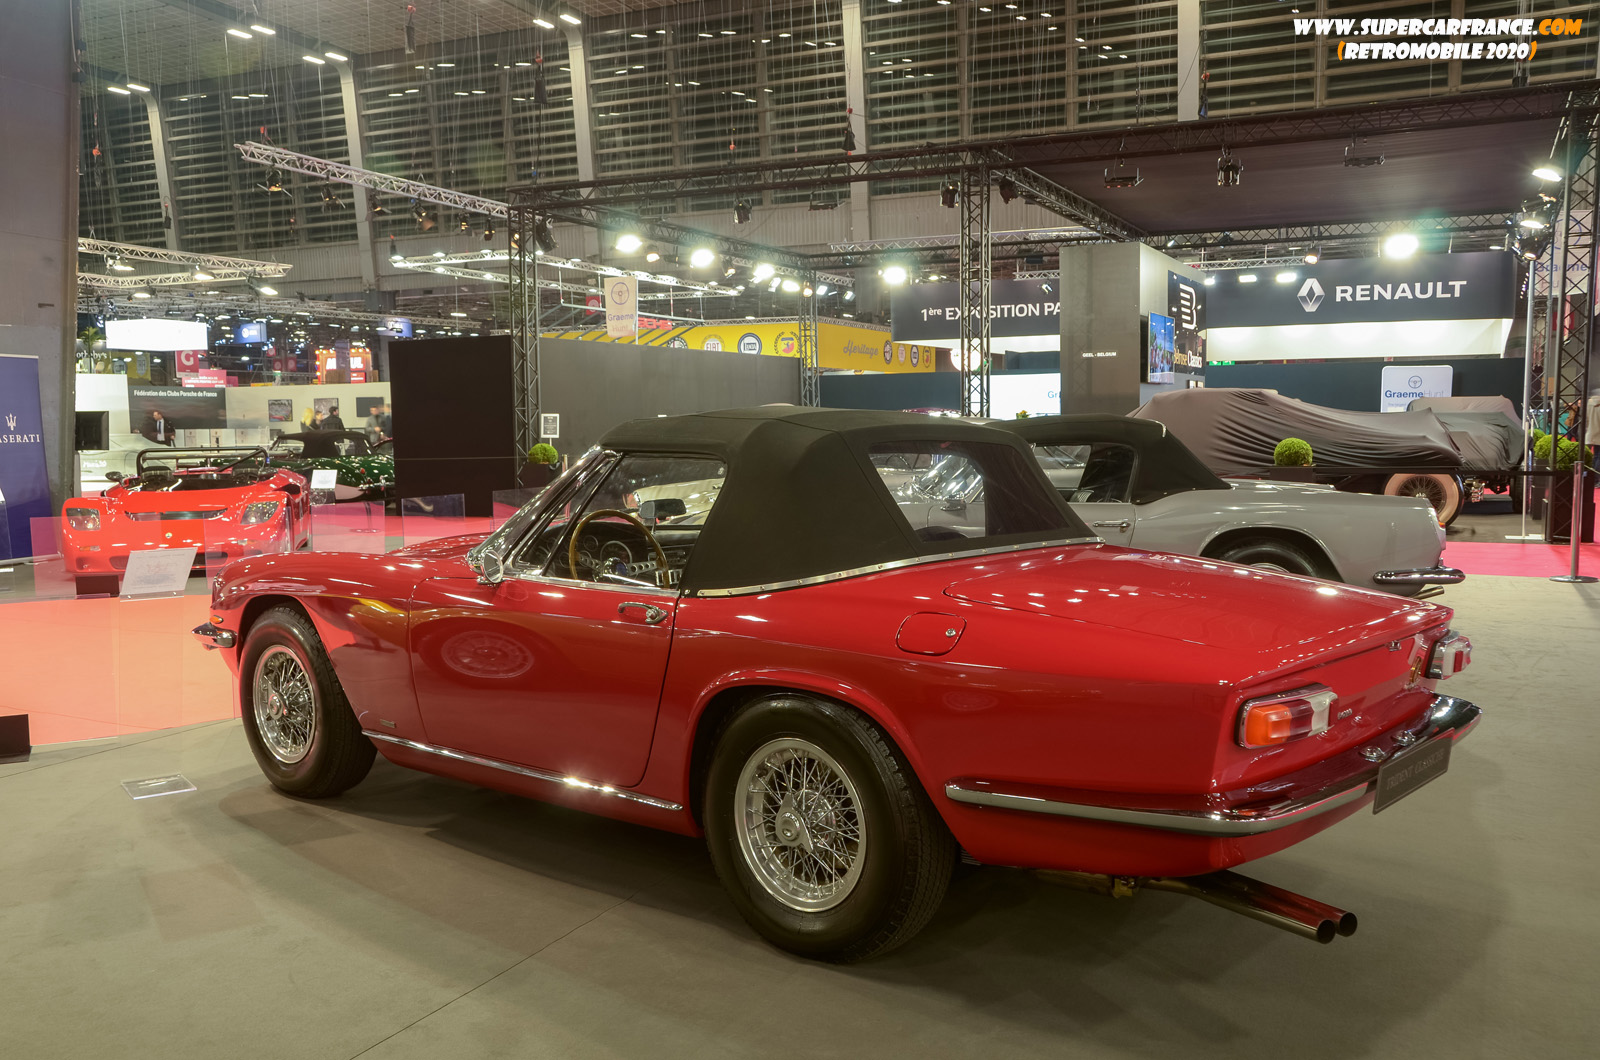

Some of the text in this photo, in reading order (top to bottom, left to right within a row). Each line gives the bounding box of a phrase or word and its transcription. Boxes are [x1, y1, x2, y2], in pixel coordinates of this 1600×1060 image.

[1335, 281, 1467, 302] RENAULT
[607, 313, 635, 322] Graeme
[921, 308, 943, 321] 1ère
[706, 342, 720, 352] FIAT
[843, 339, 879, 359] Heritage
[133, 389, 158, 397] Fédération
[180, 390, 197, 398] Porsche
[1047, 390, 1061, 399] Gr
[0, 434, 41, 444] SERATI
